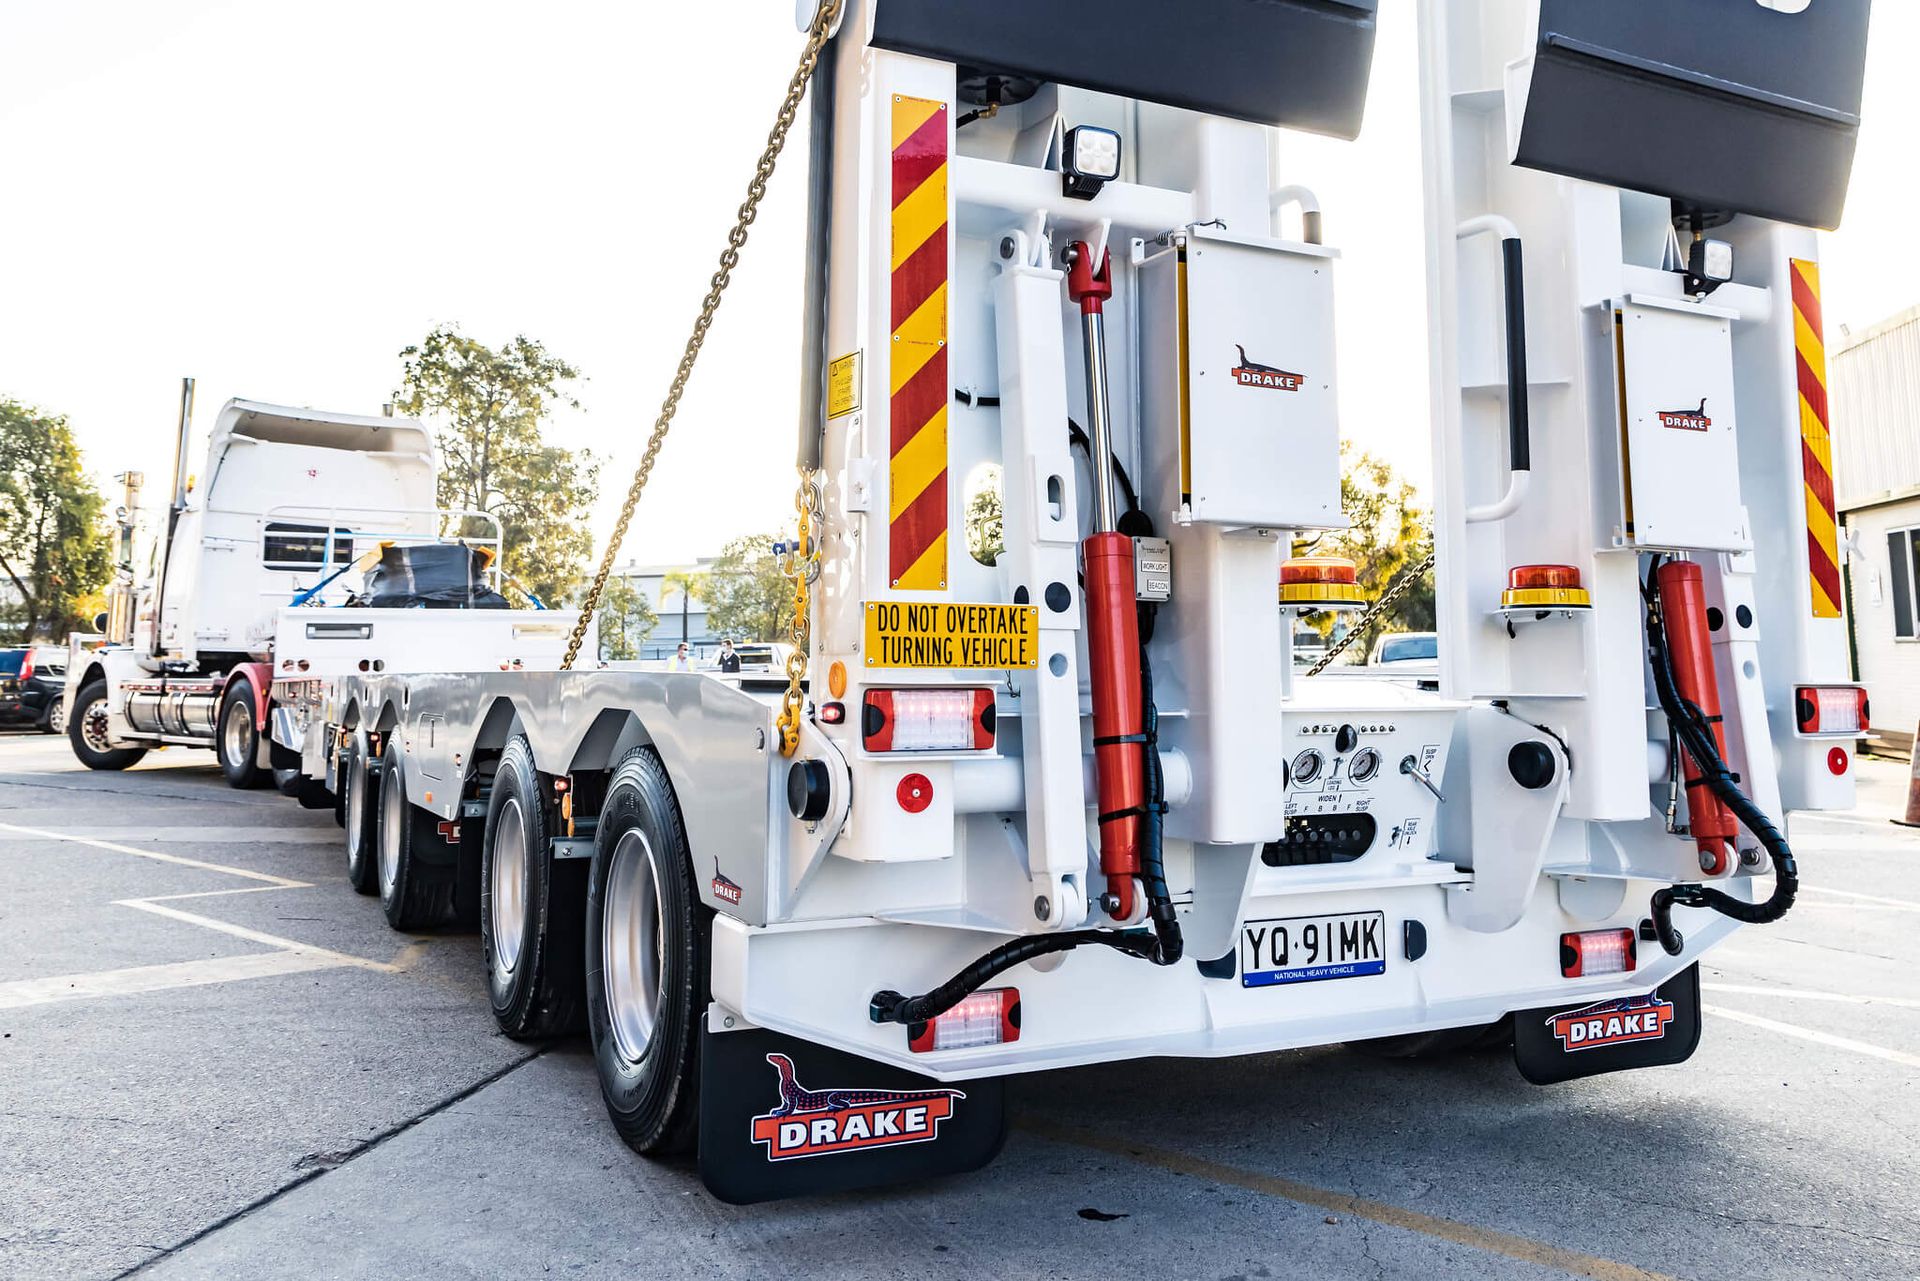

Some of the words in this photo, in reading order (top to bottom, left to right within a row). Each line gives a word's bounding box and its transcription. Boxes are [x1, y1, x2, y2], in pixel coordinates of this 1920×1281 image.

[1241, 372, 1295, 387] DRAKE
[1665, 416, 1706, 429] DRAKE
[1149, 582, 1168, 590] BEACON
[878, 604, 900, 632] DO
[908, 605, 939, 633] NOT
[946, 606, 1028, 634] OVERTAKE
[881, 636, 953, 664] TURNING
[961, 637, 1028, 665] VEHICLE
[715, 884, 738, 901] DRAKE
[1274, 970, 1306, 980] NATIONAL
[1307, 968, 1328, 978] HEAVY
[1329, 965, 1355, 975] VEHICLE
[1569, 1012, 1658, 1043] DRAKE
[779, 1106, 928, 1149] DRAKE
